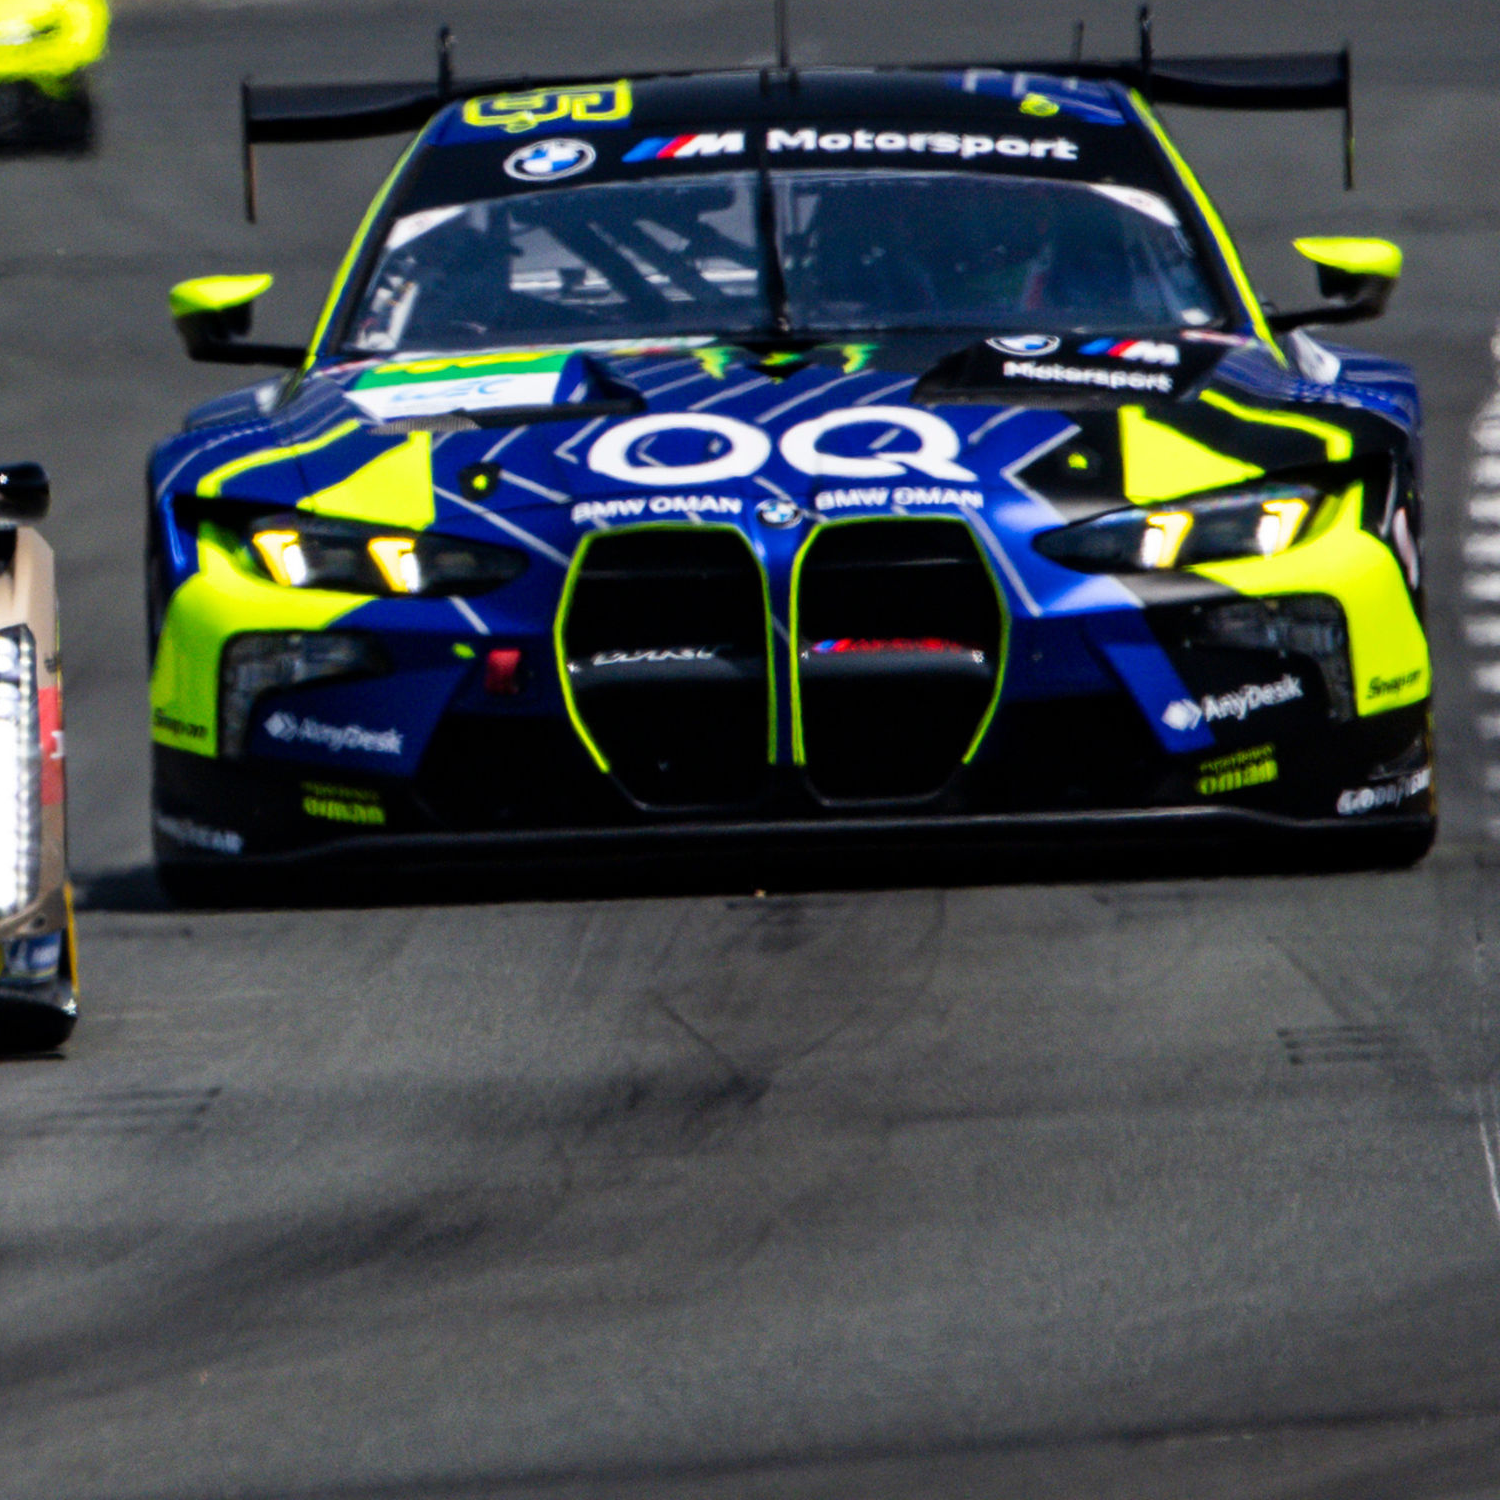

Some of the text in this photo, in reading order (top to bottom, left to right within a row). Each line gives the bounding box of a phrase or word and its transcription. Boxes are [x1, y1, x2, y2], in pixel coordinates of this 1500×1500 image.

[766, 129, 1079, 161] Motorsport
[1002, 360, 1173, 393] Motorsport
[586, 405, 980, 486] OQ
[570, 495, 743, 525] BMW OMAN
[813, 487, 985, 512] BMW OMAN
[1202, 673, 1304, 722] AnyDesk
